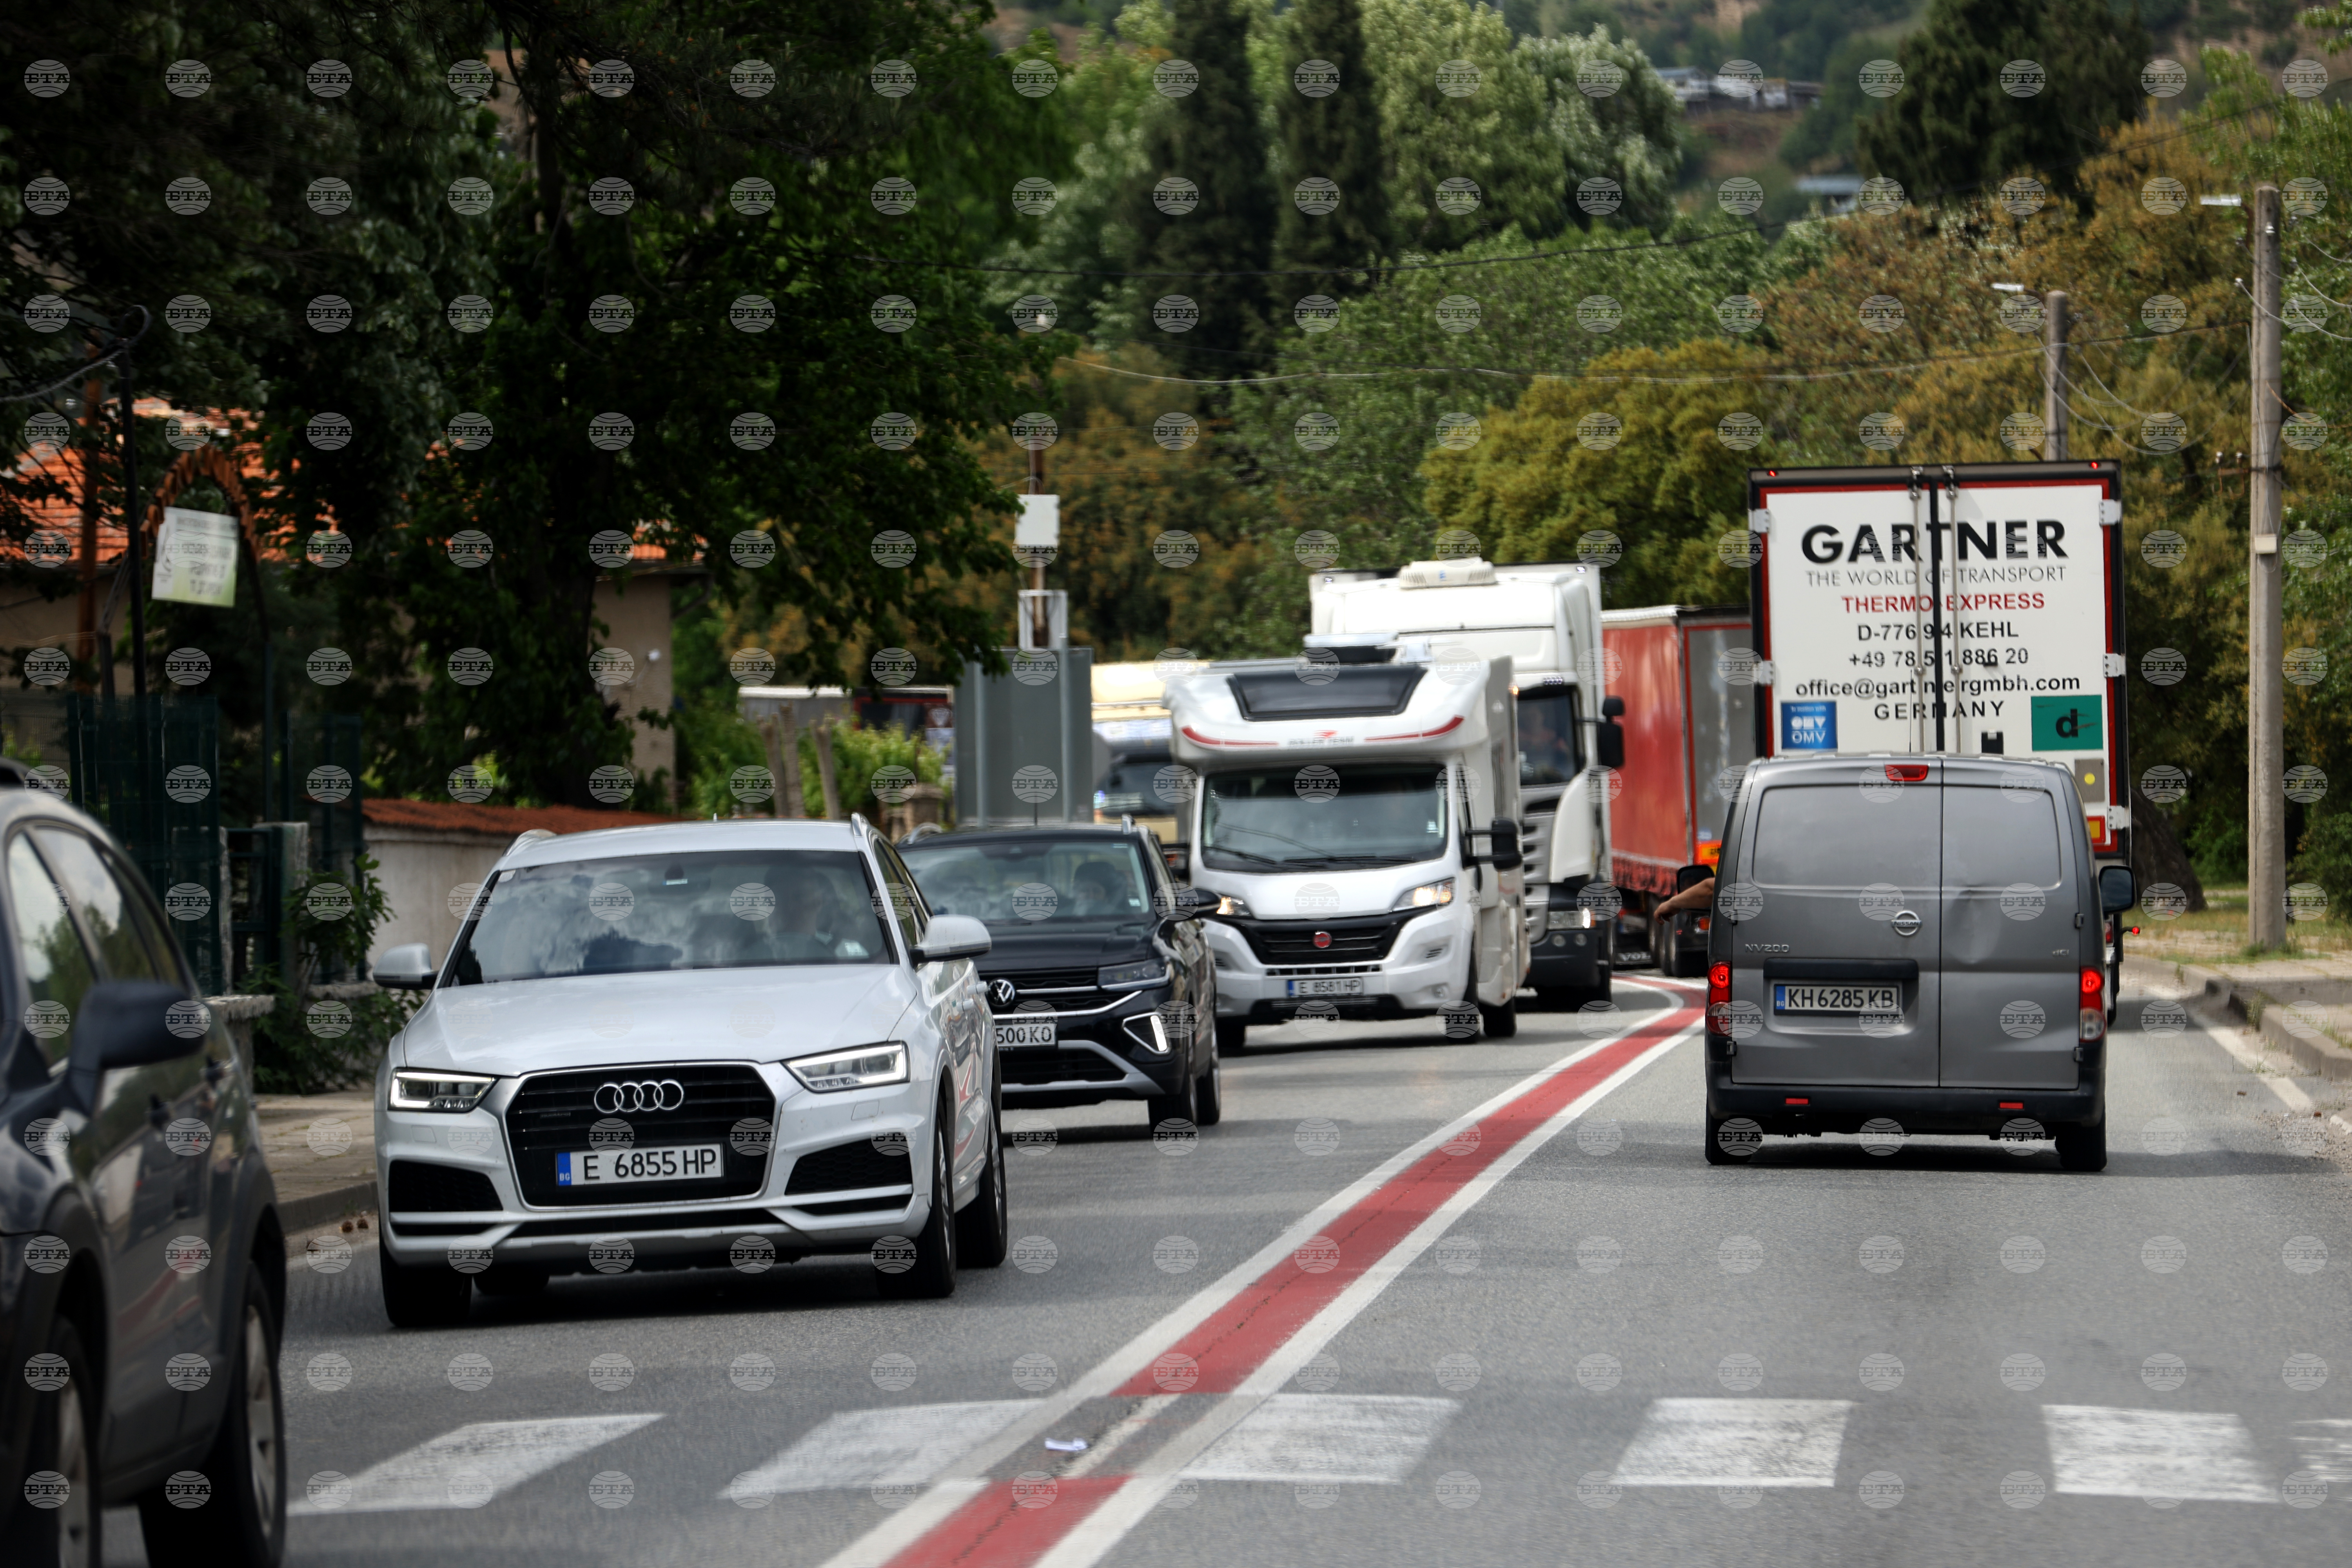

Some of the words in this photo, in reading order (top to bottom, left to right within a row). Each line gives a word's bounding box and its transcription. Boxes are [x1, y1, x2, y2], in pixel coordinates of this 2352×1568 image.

[1800, 519, 2070, 565] GARTNER
[1806, 570, 1841, 588] THE
[1847, 568, 1917, 586] WORLD
[1957, 565, 2066, 584] TRANSPORT
[1858, 624, 1953, 641] D-77694
[1960, 621, 2019, 638] KEHL
[1849, 651, 1885, 667] +49
[1892, 649, 1953, 667] 7851
[1962, 648, 1998, 665] 886
[2005, 648, 2028, 664] 20
[1796, 676, 2080, 699] office@gartnergmbh.com
[2056, 709, 2078, 739] d
[1791, 731, 1826, 743] OMV
[1745, 944, 1789, 953] NV200
[1299, 982, 1308, 993] E
[1788, 988, 1813, 1008] KH
[1818, 989, 1864, 1008] 6285
[1869, 990, 1893, 1009] KB
[559, 1172, 570, 1181] BG
[583, 1154, 600, 1180] E
[614, 1151, 677, 1178] 6855
[682, 1148, 717, 1175] HP
